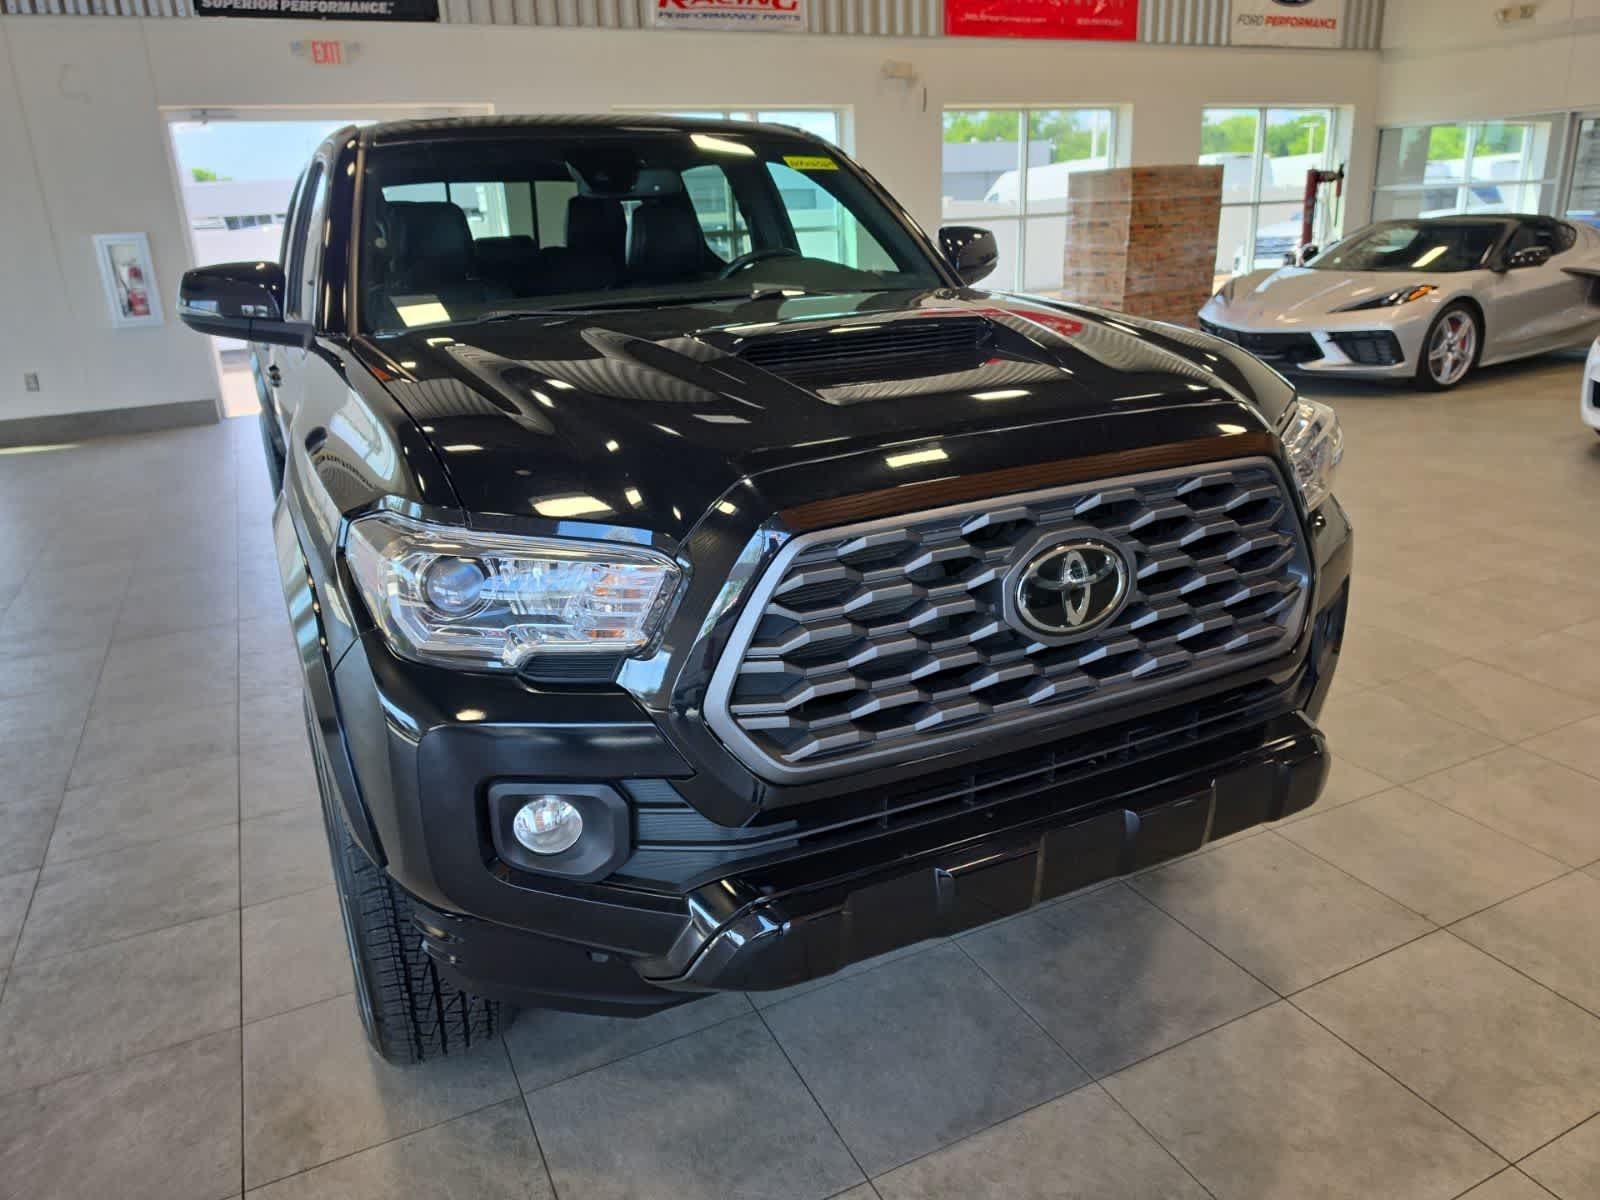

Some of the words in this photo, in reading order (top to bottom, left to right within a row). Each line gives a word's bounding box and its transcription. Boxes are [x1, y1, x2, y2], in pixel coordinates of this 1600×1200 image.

[202, 0, 278, 10] SUPERIOR
[659, 12, 756, 20] PERFORMANCE
[1237, 14, 1263, 26] FORD
[1264, 16, 1336, 29] PERFORMANCE
[312, 40, 341, 65] EXIT
